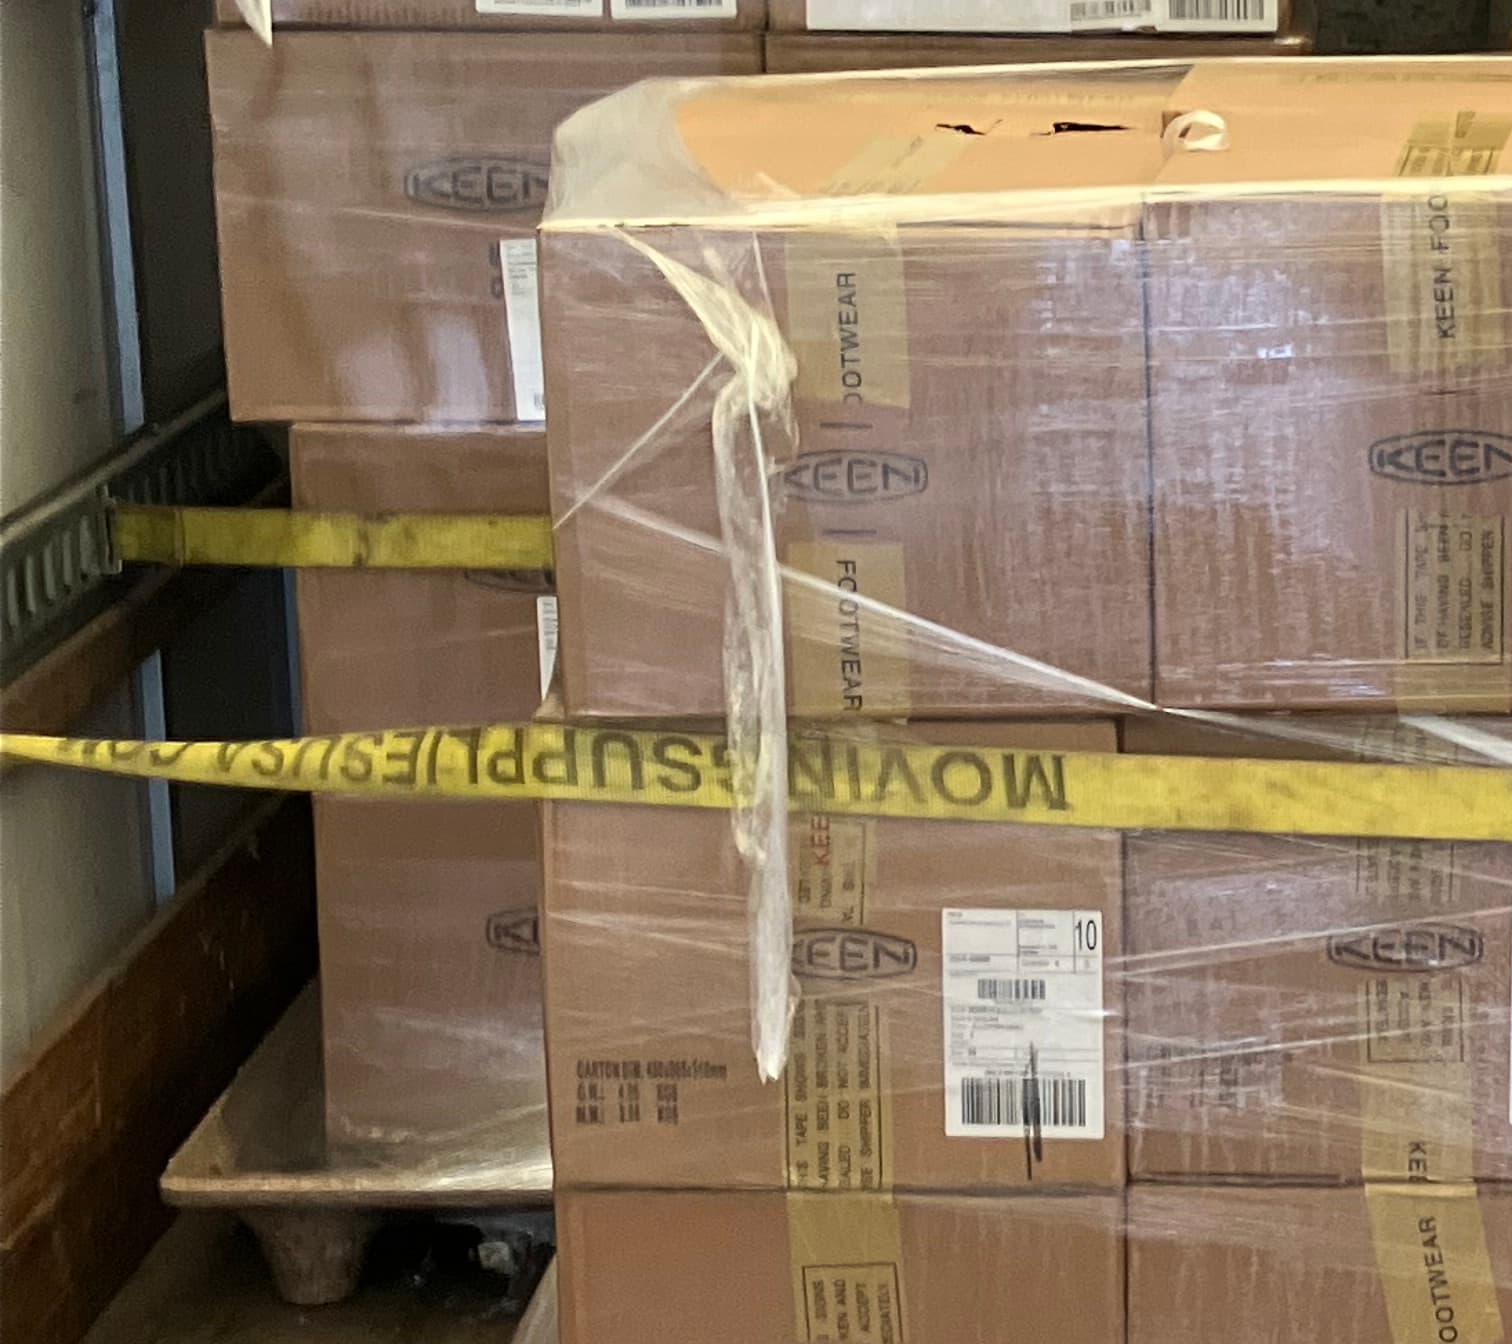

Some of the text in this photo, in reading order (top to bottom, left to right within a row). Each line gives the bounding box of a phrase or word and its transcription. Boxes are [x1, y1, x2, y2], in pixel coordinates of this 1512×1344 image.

[1433, 269, 1457, 340] KEEN
[1075, 918, 1098, 951] 10
[1332, 928, 1477, 966] KEEN
